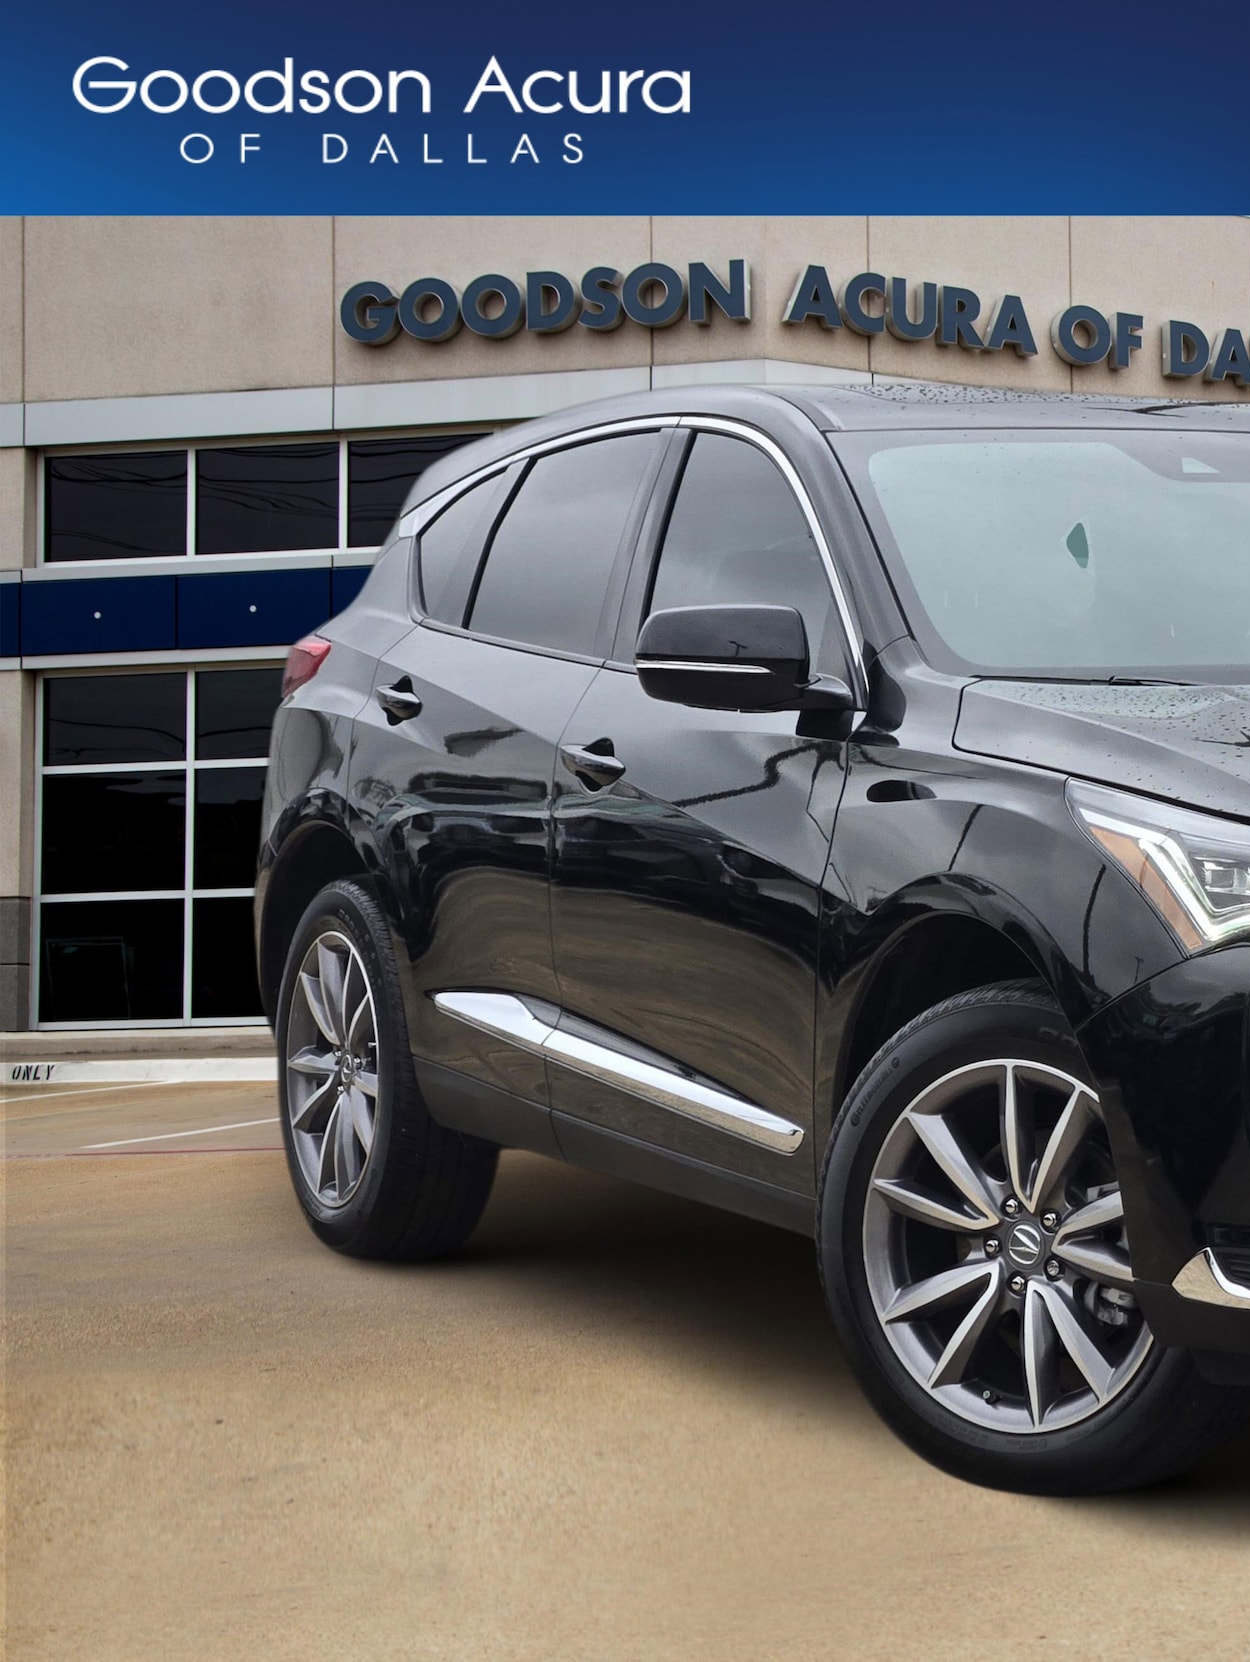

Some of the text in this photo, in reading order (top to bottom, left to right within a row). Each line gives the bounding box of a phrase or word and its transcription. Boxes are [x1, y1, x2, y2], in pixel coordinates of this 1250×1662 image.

[340, 259, 751, 346] GOODSON
[782, 264, 1038, 356] ACURA
[1052, 305, 1143, 369] OF
[11, 1064, 55, 1081] ONLY
